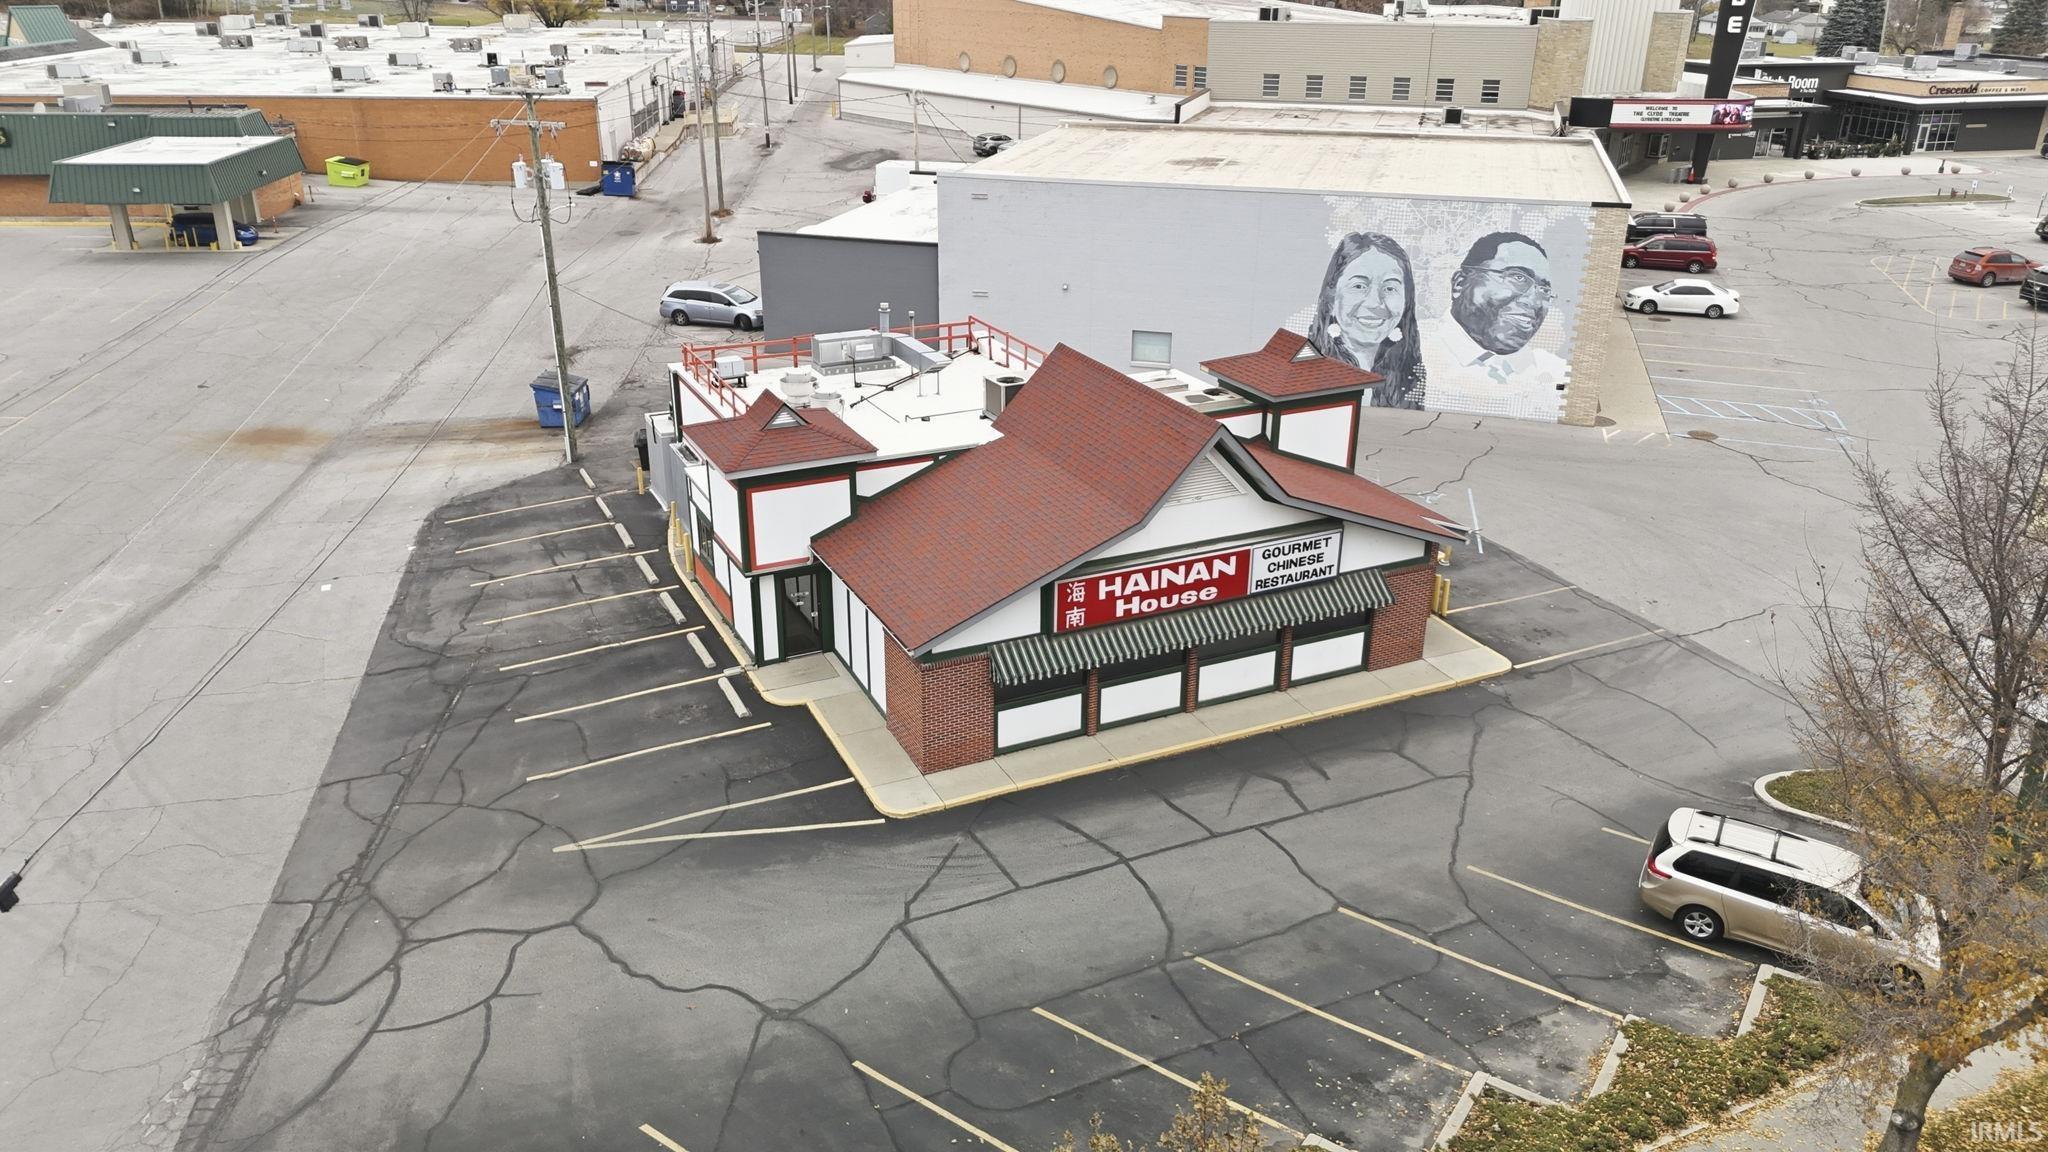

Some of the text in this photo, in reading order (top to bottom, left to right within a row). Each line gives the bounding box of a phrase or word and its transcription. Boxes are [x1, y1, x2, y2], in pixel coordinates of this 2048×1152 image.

[1789, 75, 1819, 89] Room
[1929, 83, 1979, 95] Crescendo
[1262, 536, 1333, 560] GOURMET
[1268, 552, 1325, 573] CHINESE
[1098, 555, 1237, 601] HAINAN
[1255, 564, 1335, 591] RESTAURANT
[1065, 581, 1086, 629] 海南
[1115, 586, 1218, 618] House
